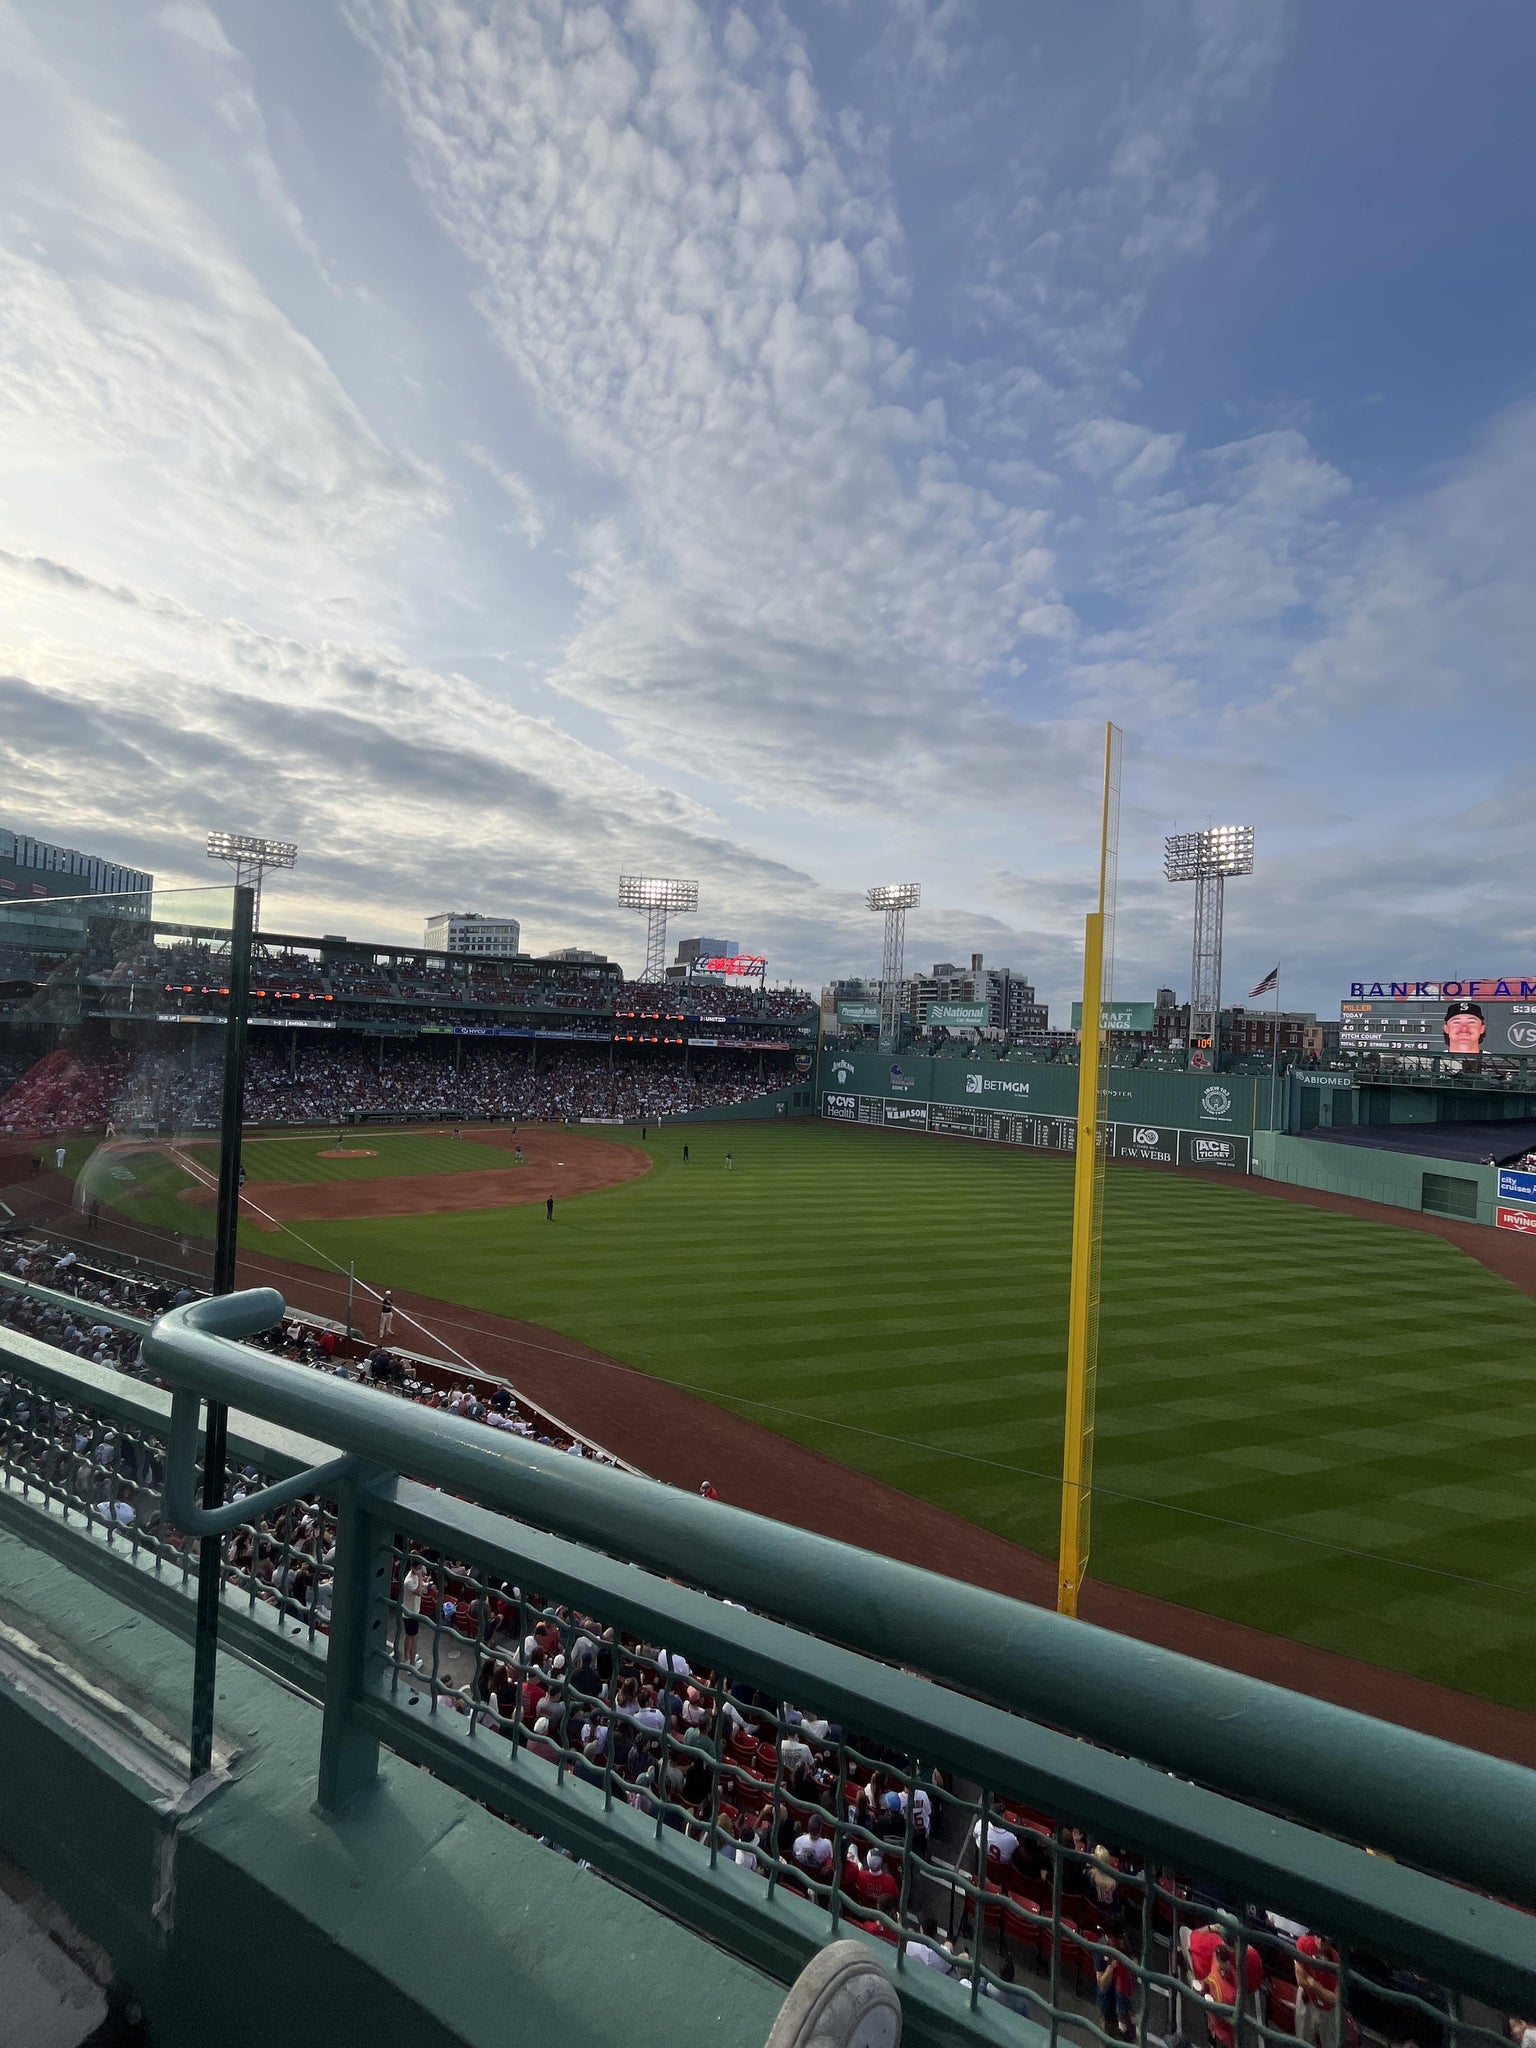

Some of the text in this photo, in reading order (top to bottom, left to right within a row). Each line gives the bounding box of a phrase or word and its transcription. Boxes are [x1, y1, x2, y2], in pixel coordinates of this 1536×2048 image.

[1350, 982, 1430, 996] BANK
[1442, 981, 1483, 997] OF
[943, 1007, 984, 1017] National
[1512, 1028, 1536, 1042] VS
[1198, 1039, 1212, 1048] 109
[984, 1080, 1029, 1093] BETMGM
[1304, 1076, 1351, 1086] ABIOMED
[836, 1096, 855, 1107] CVS
[827, 1106, 855, 1118] Health
[1199, 1140, 1230, 1152] ACE
[1140, 1149, 1170, 1161] WEBB
[1501, 1177, 1517, 1186] city
[1501, 1183, 1531, 1194] cruises
[1504, 1214, 1536, 1227] IRVING
